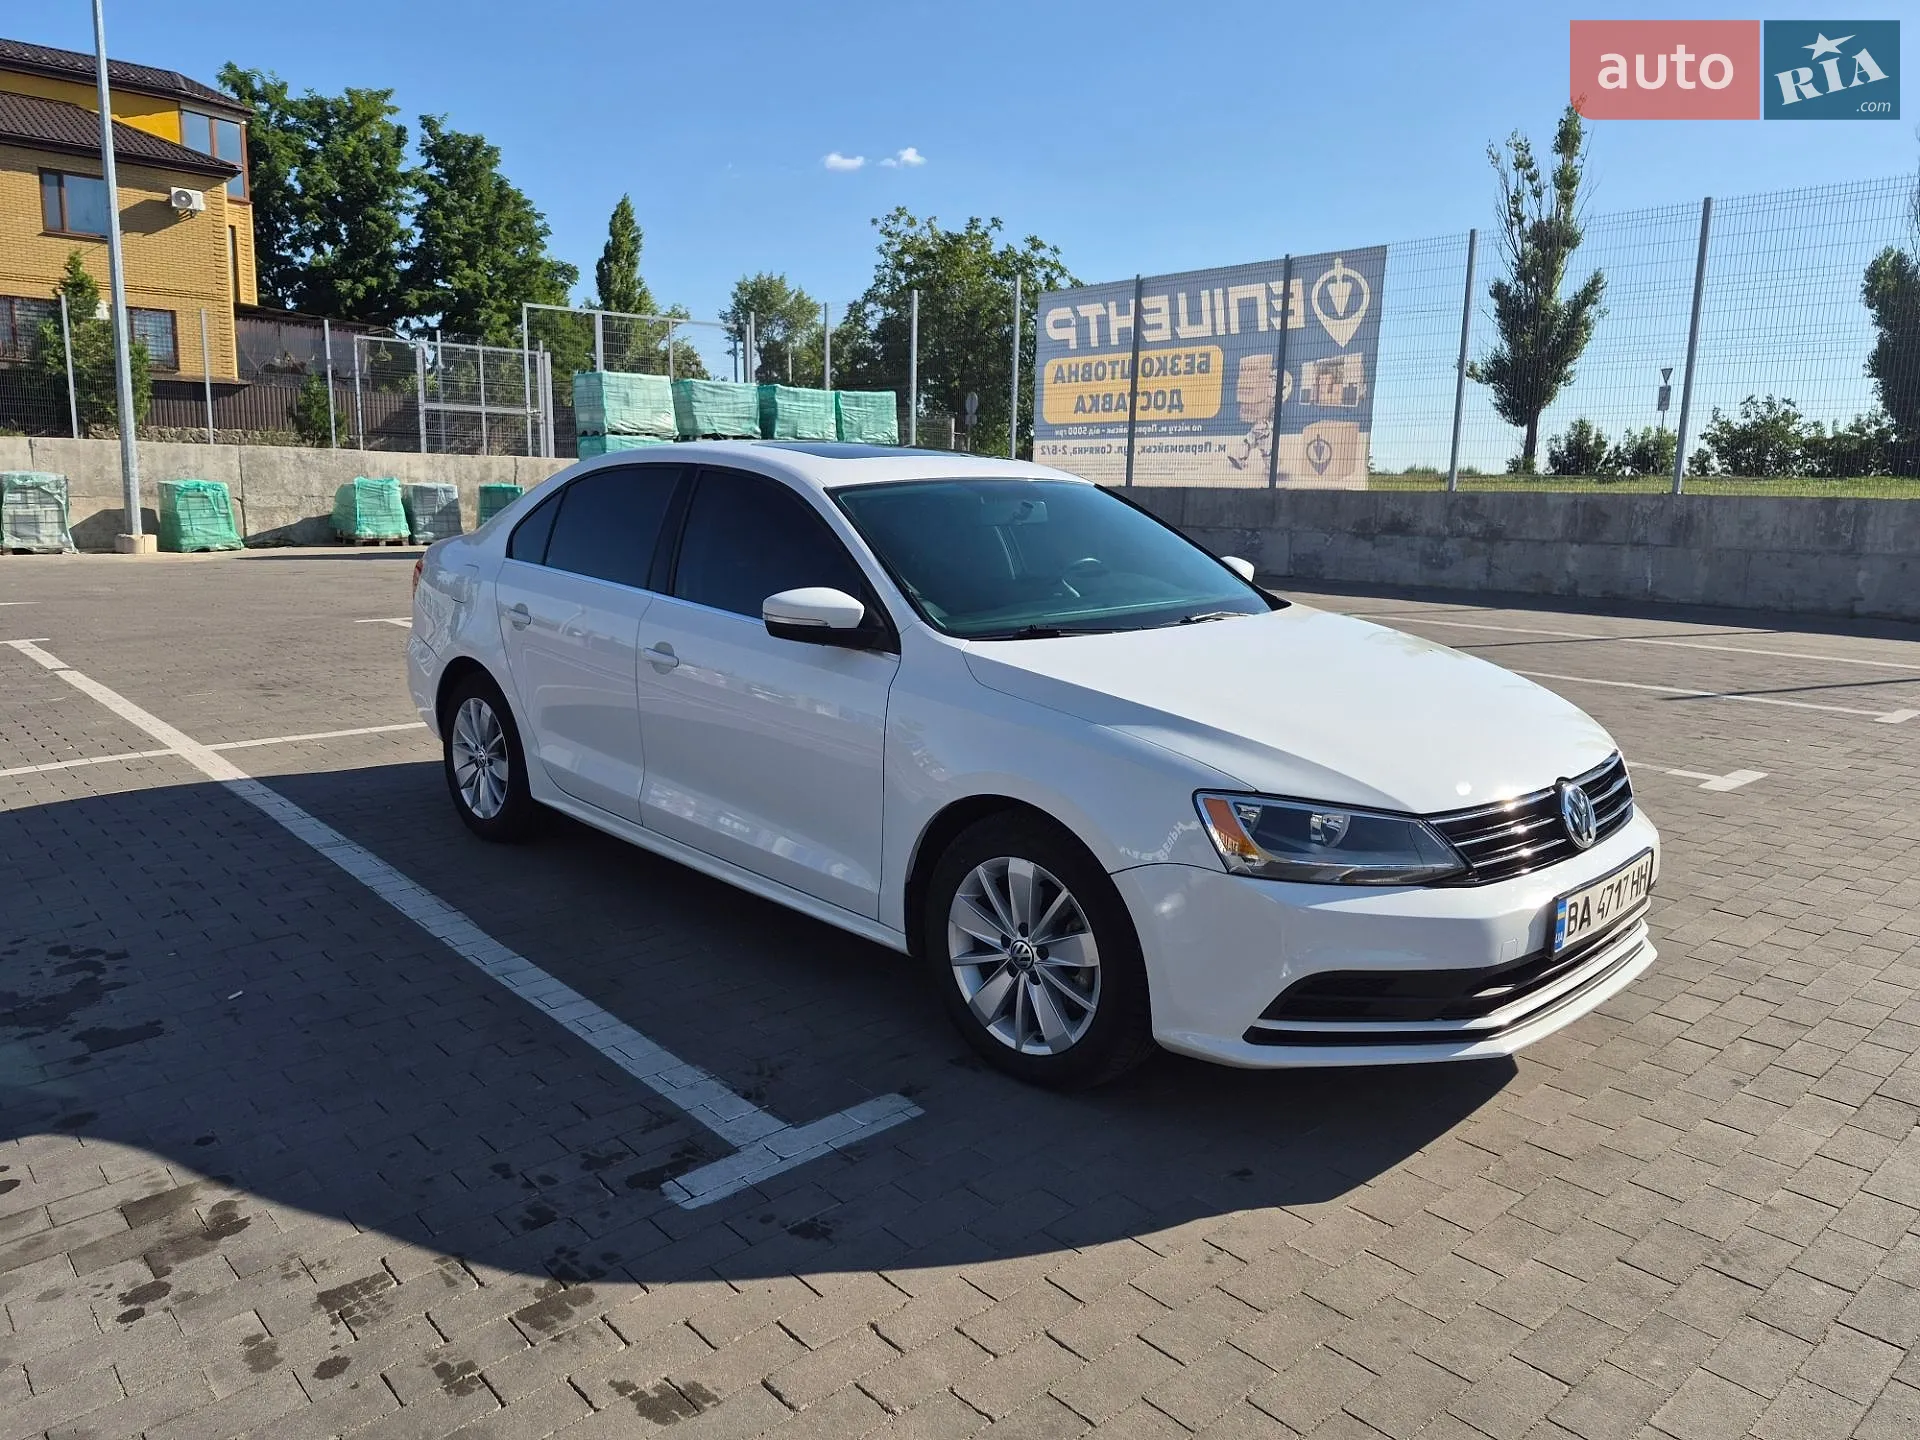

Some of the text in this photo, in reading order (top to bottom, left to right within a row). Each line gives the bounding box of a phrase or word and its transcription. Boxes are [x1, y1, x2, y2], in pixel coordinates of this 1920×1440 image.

[1566, 861, 1649, 938] BA 4717 HH
